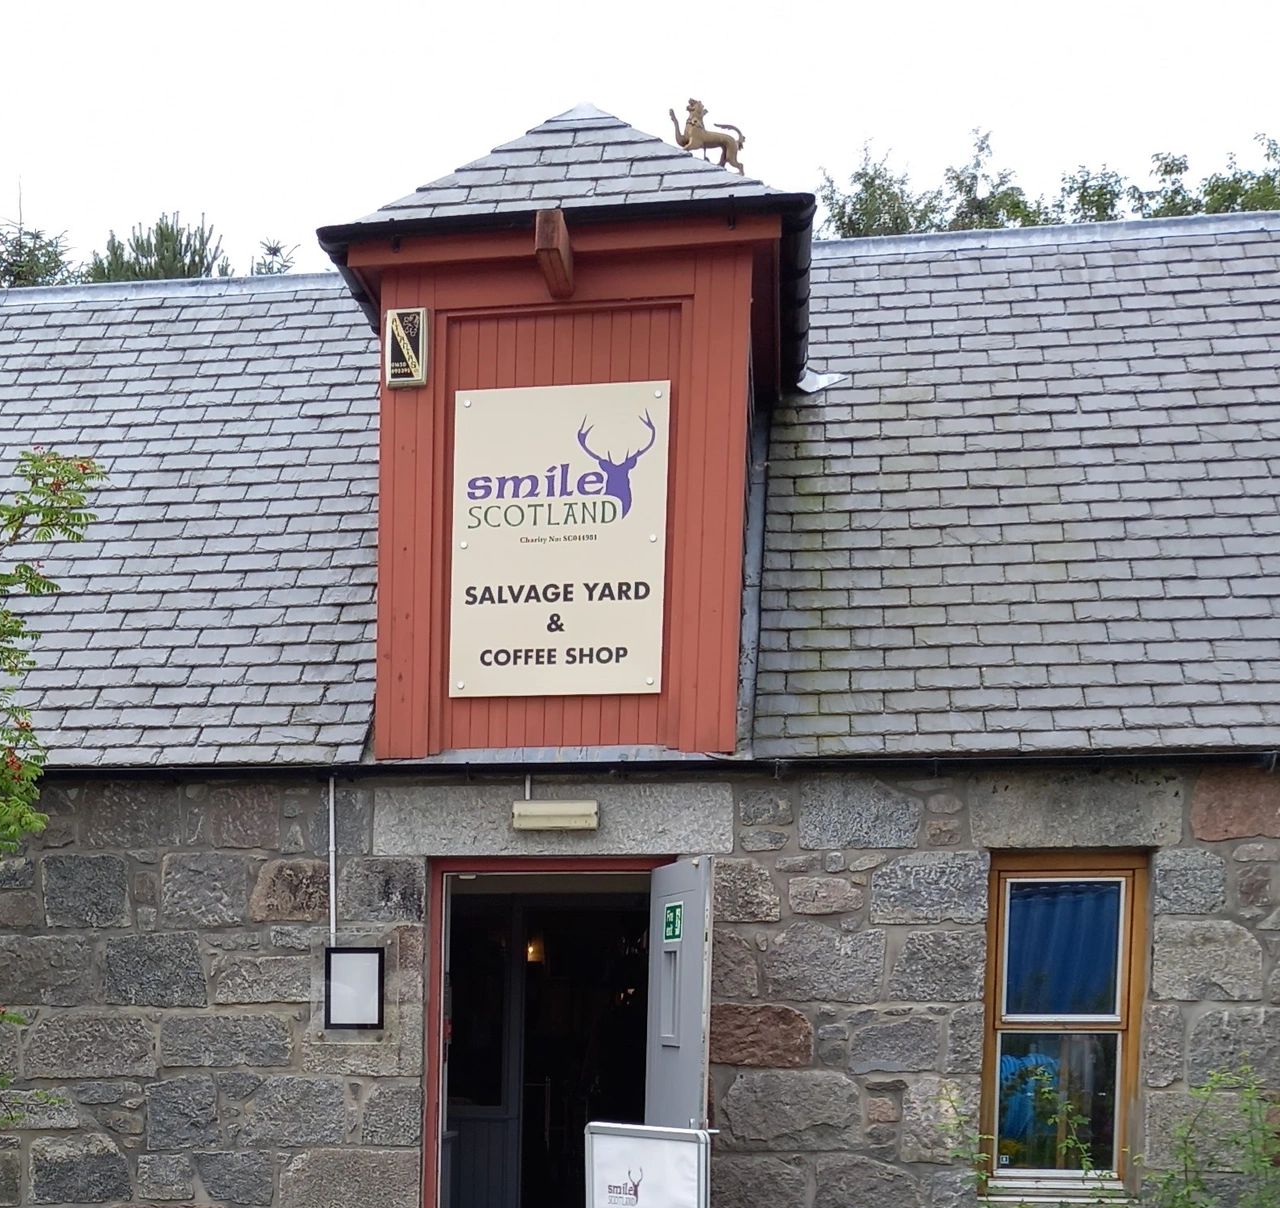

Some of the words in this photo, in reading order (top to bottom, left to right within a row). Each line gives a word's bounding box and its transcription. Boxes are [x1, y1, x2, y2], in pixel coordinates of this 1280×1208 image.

[467, 463, 604, 500] smile
[467, 500, 617, 529] SCOTLAND
[519, 535, 547, 545] Charity
[464, 583, 574, 605] SALVAGE
[583, 581, 651, 601] YARD
[546, 613, 565, 632] &
[479, 648, 557, 666] COFFEE
[565, 646, 628, 665] SHOP
[608, 1182, 634, 1196] smile
